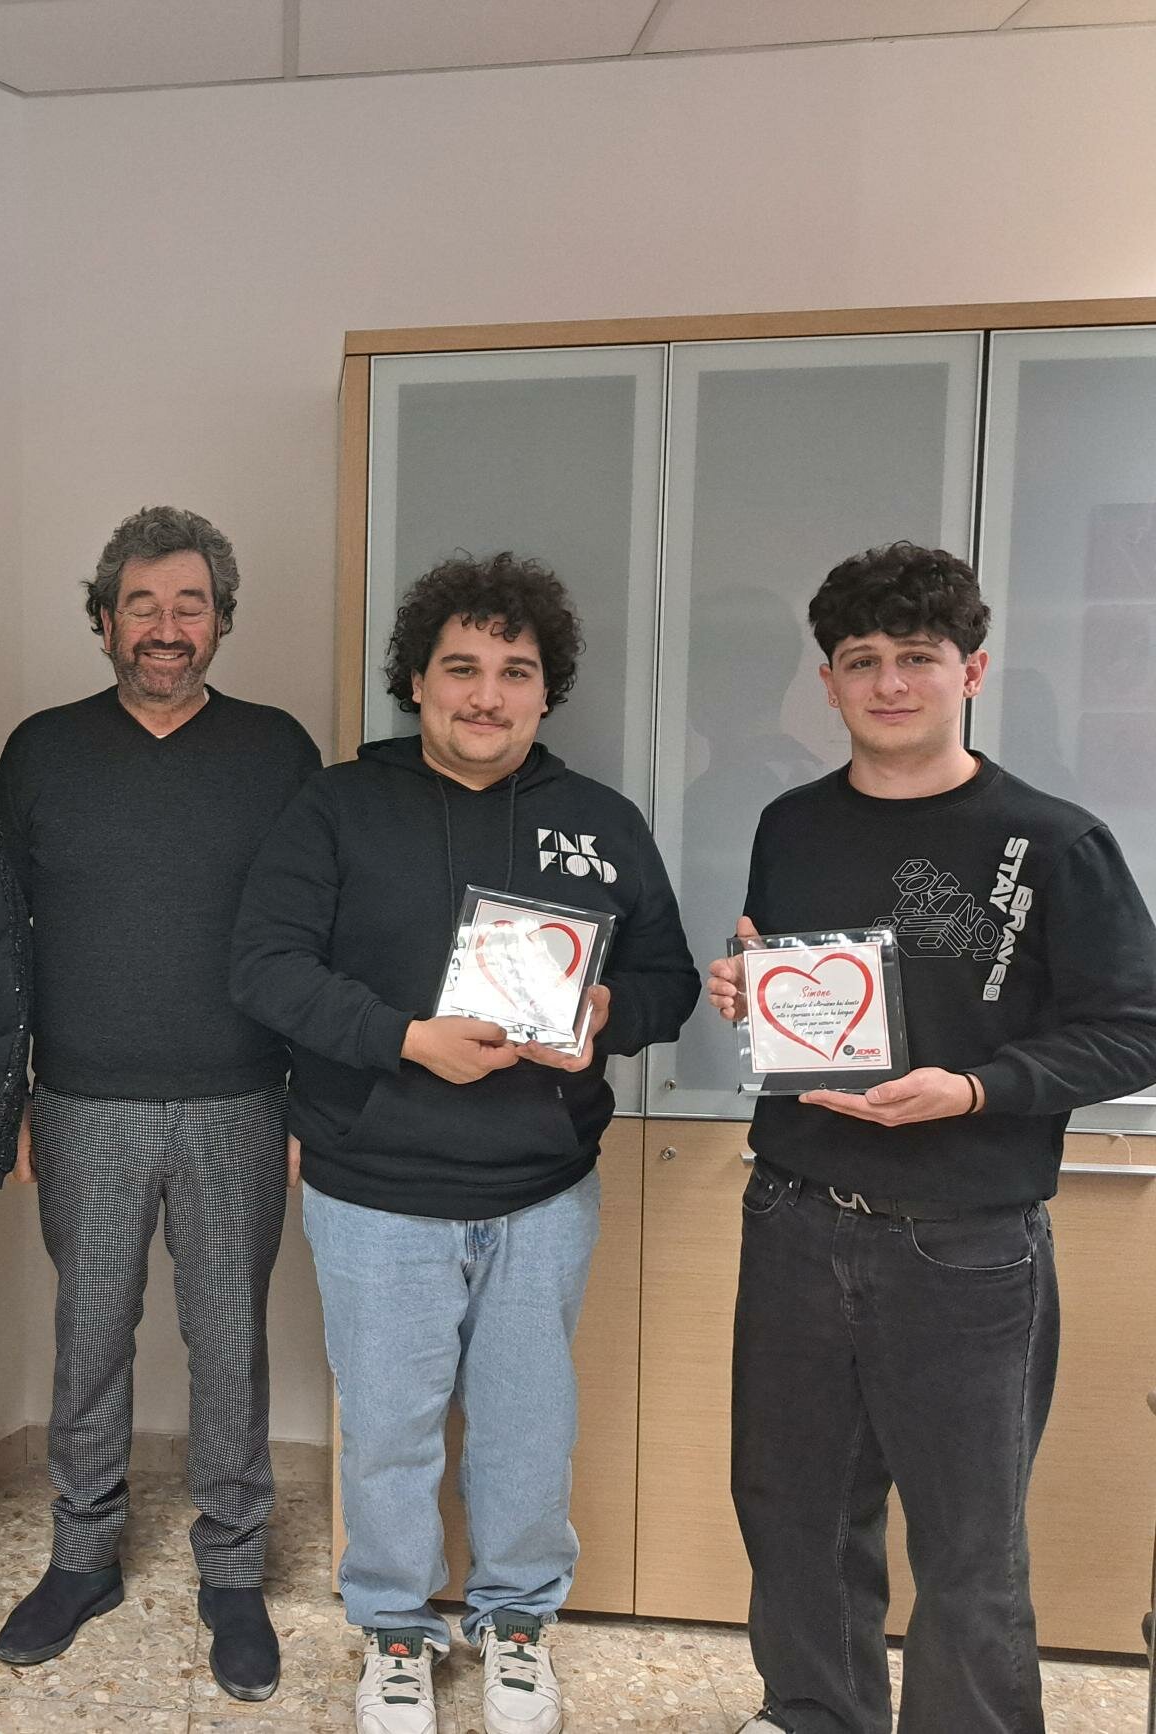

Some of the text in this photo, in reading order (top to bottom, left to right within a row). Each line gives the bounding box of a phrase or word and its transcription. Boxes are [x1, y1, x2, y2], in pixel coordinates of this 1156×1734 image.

[537, 828, 598, 857] PINK
[539, 850, 618, 884] FLOYD
[989, 837, 1030, 914] STAY
[986, 885, 1035, 986] BRAVE
[802, 985, 832, 998] Simone
